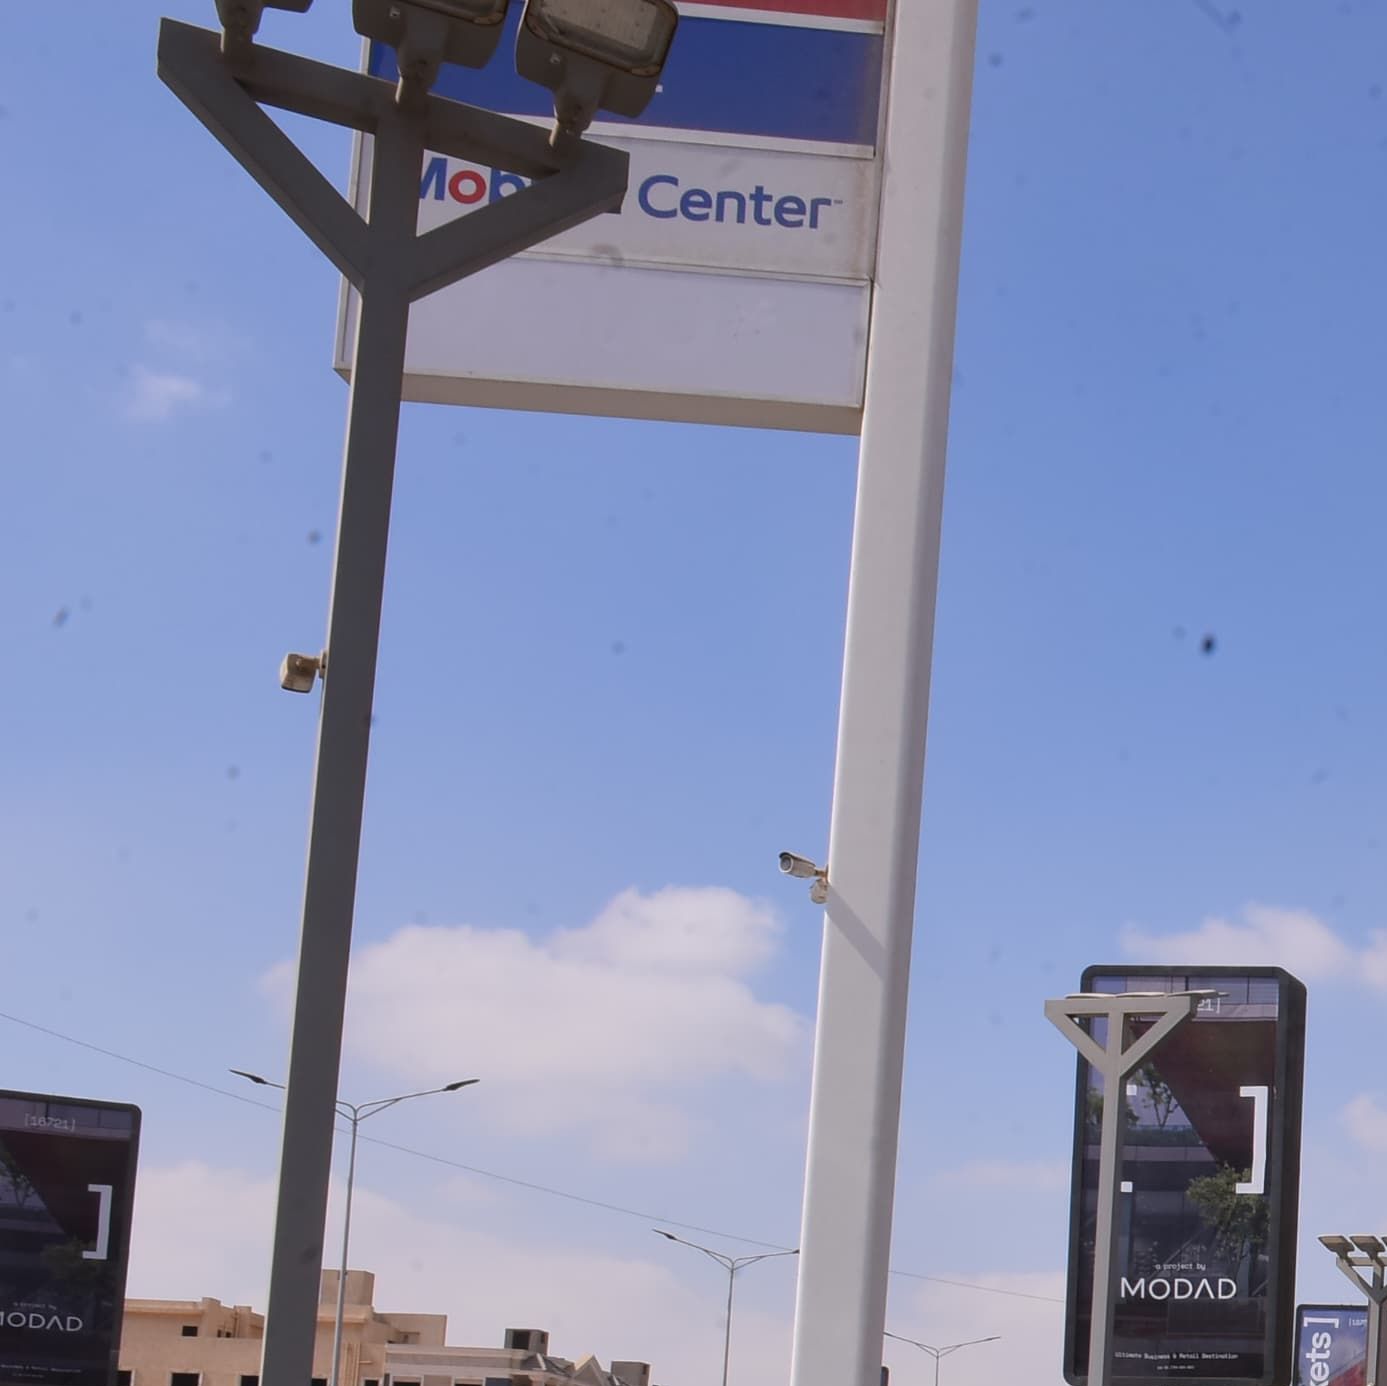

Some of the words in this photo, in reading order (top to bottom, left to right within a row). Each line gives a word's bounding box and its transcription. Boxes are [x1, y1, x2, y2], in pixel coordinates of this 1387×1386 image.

[638, 174, 832, 230] Center
[1163, 1263, 1193, 1271] project
[1196, 1263, 1206, 1271] by
[1120, 1277, 1237, 1300] MODAD
[0, 1311, 83, 1332] ODAD
